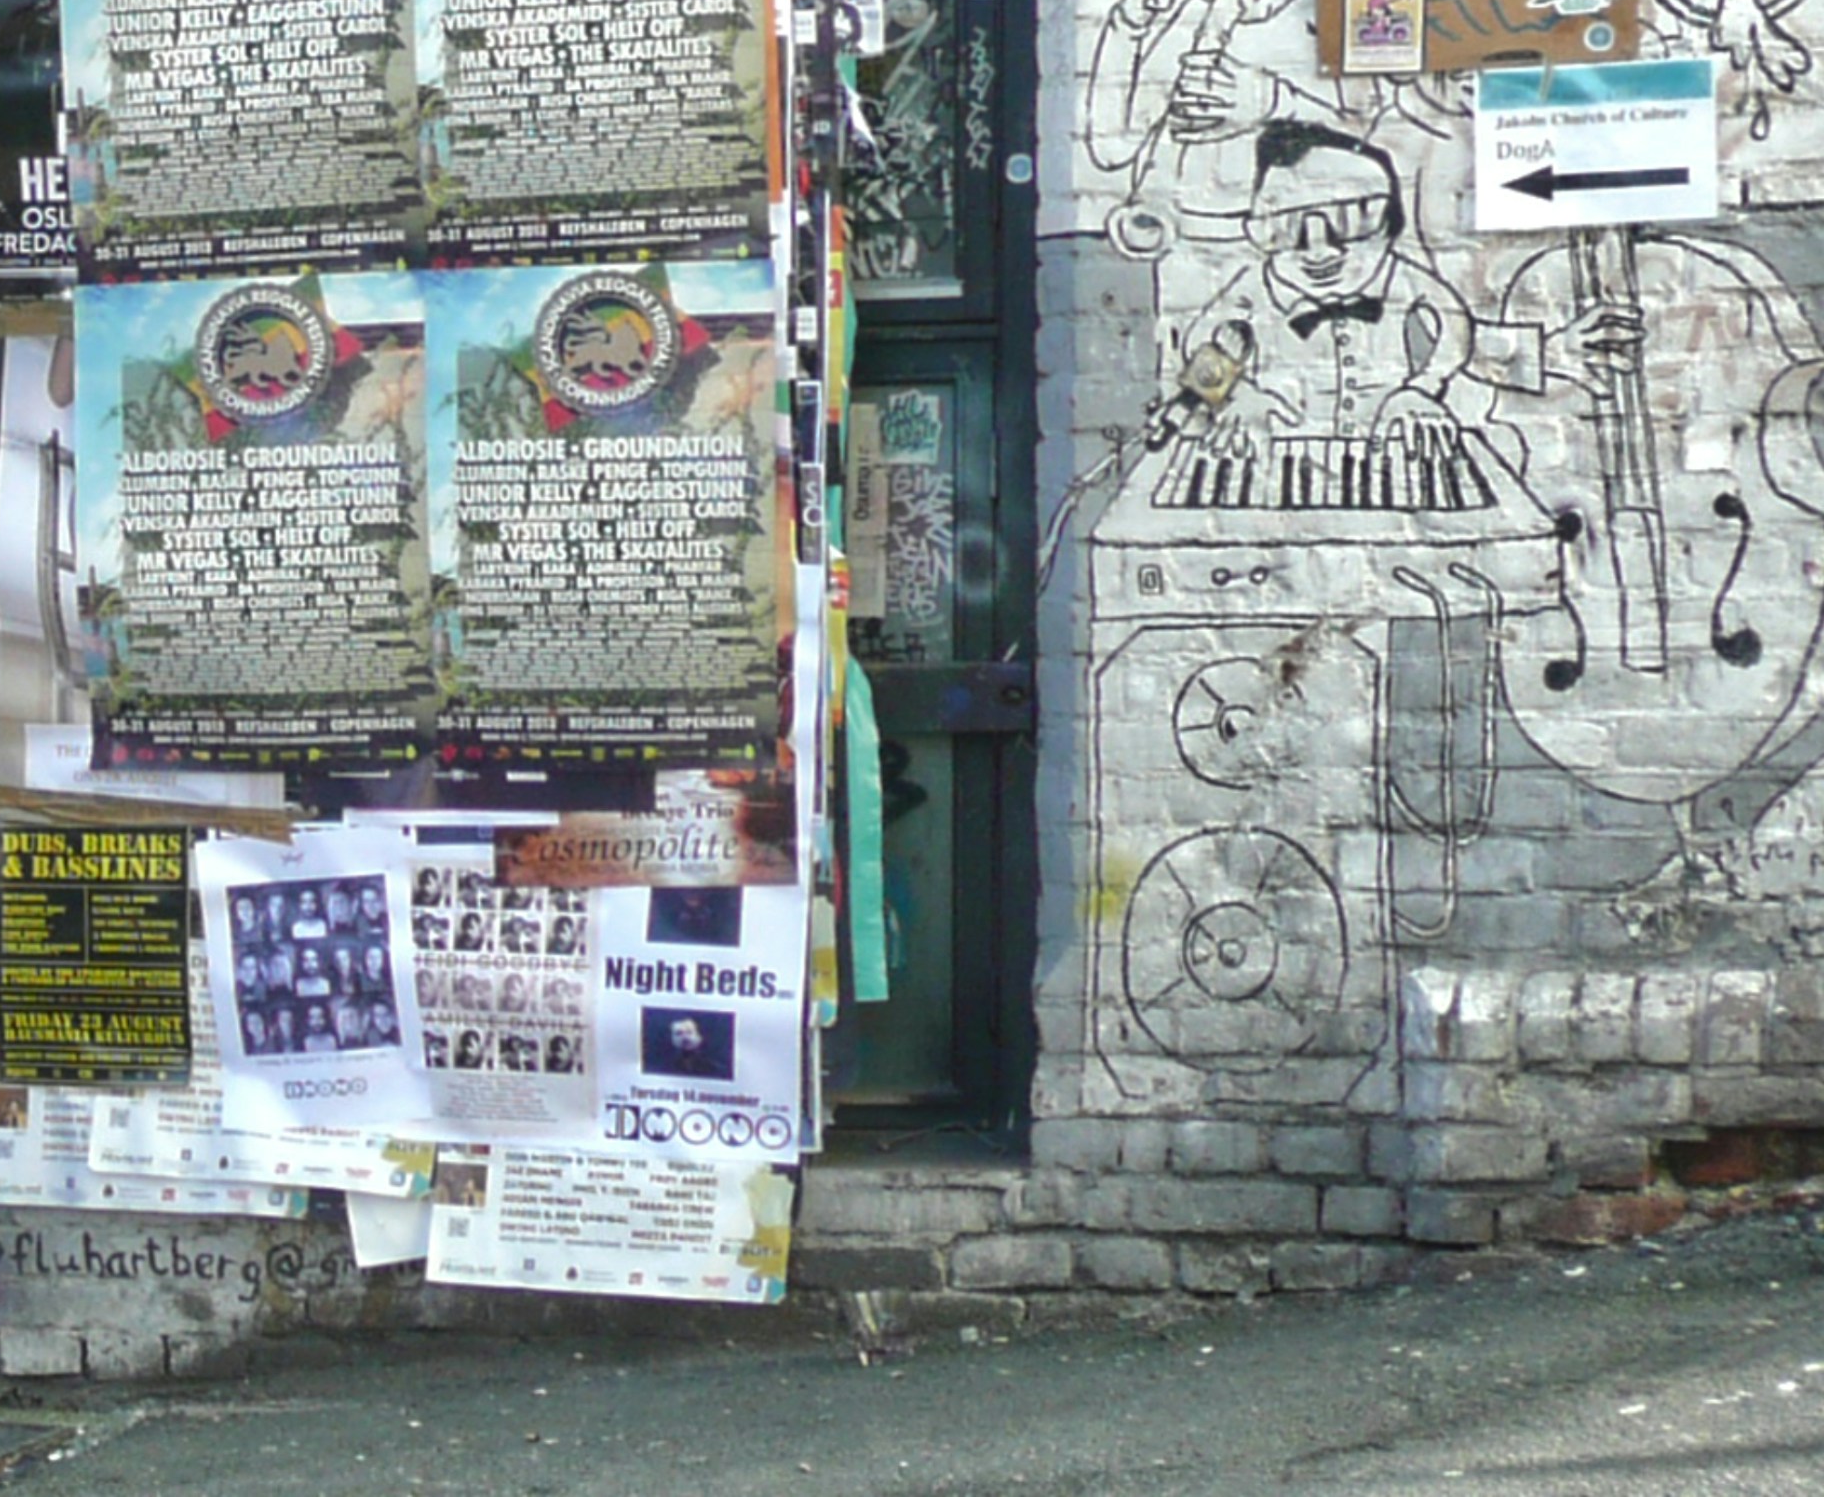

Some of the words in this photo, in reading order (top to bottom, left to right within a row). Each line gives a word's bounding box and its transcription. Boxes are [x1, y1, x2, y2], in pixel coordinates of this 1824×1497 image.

[182, 8, 231, 28] KELLY
[485, 27, 548, 46] SYSTER
[555, 25, 587, 42] SOL
[603, 21, 645, 39] HELT
[652, 18, 683, 35] OFF
[151, 48, 212, 69] SYSTER
[218, 45, 247, 63] SOL
[263, 42, 301, 60] HELT
[306, 39, 337, 56] OFF
[460, 52, 489, 68] MR
[494, 47, 553, 66] VEGAS
[570, 45, 603, 62] THE
[610, 38, 711, 60] SKATALITES
[125, 72, 153, 88] MR
[158, 67, 215, 86] VEGAS
[231, 64, 262, 82] THE
[268, 57, 365, 80] SKATALITES
[1552, 107, 1607, 127] Church
[1611, 106, 1627, 124] of
[1629, 104, 1690, 123] Culture
[1495, 138, 1556, 165] DogA
[21, 207, 70, 231] OSL
[123, 449, 226, 471] ALBOROSIE
[243, 443, 396, 468] GROUNDATION
[456, 440, 566, 461] ALBOROSIE
[584, 437, 742, 459] GROUNDATION
[192, 493, 241, 511] KELLY
[530, 483, 582, 501] KELLY
[163, 532, 224, 550] SYSTER
[229, 530, 260, 547] SOL
[275, 528, 314, 546] HELT
[319, 527, 350, 544] OFF
[500, 523, 561, 540] SYSTER
[568, 522, 599, 539] SOL
[616, 521, 657, 538] HELT
[662, 521, 695, 537] OFF
[137, 554, 165, 570] MR
[172, 551, 228, 569] VEGAS
[245, 550, 274, 567] THE
[280, 547, 378, 565] SKATALITES
[473, 546, 502, 560] MR
[507, 544, 567, 560] VEGAS
[583, 544, 614, 559] THE
[621, 541, 723, 559] SKATALITES
[2, 832, 74, 856] DUBS,
[82, 832, 182, 855] BREAKS
[2, 856, 23, 879] &
[32, 855, 182, 881] BASSLINES
[604, 956, 687, 997] Night
[694, 962, 777, 1000] Beds
[4, 1012, 74, 1029] FRIDAY
[108, 1015, 183, 1031] AUGUST
